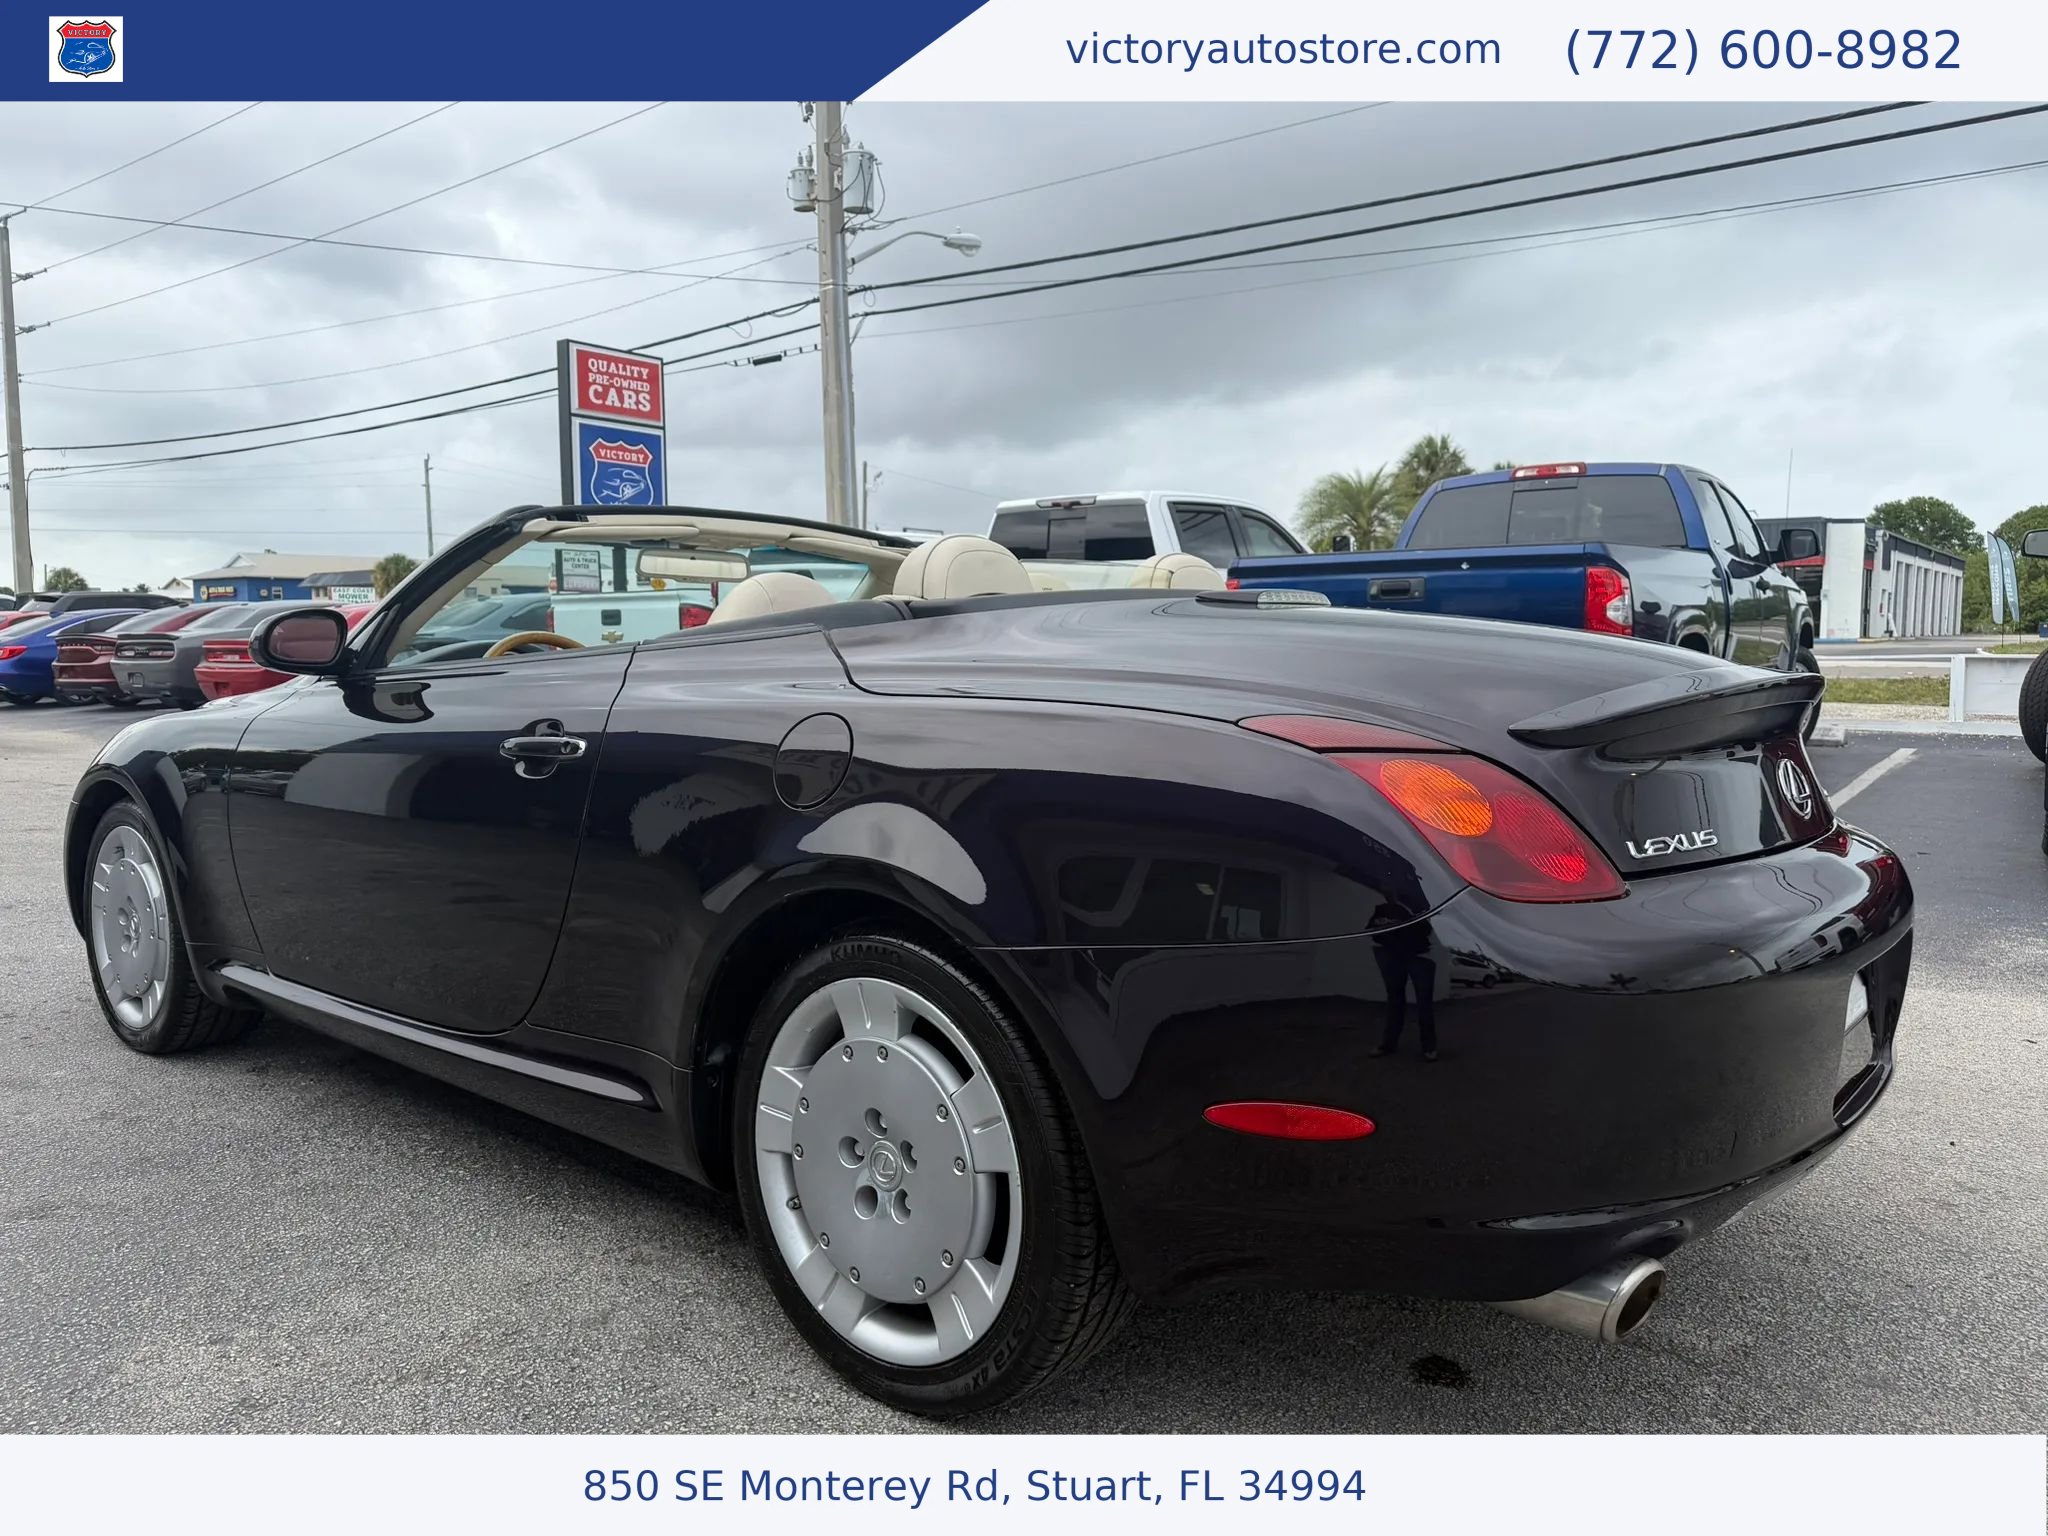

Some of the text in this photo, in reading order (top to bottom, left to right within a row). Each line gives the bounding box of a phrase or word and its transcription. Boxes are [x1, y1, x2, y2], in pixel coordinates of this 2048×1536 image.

[588, 358, 649, 379] QUALITY
[588, 372, 650, 392] PRE-OWNED
[588, 384, 651, 412] CARS
[599, 448, 645, 463] VICTORY
[2004, 567, 2013, 602] TIRES
[1625, 829, 1719, 859] LEXUS
